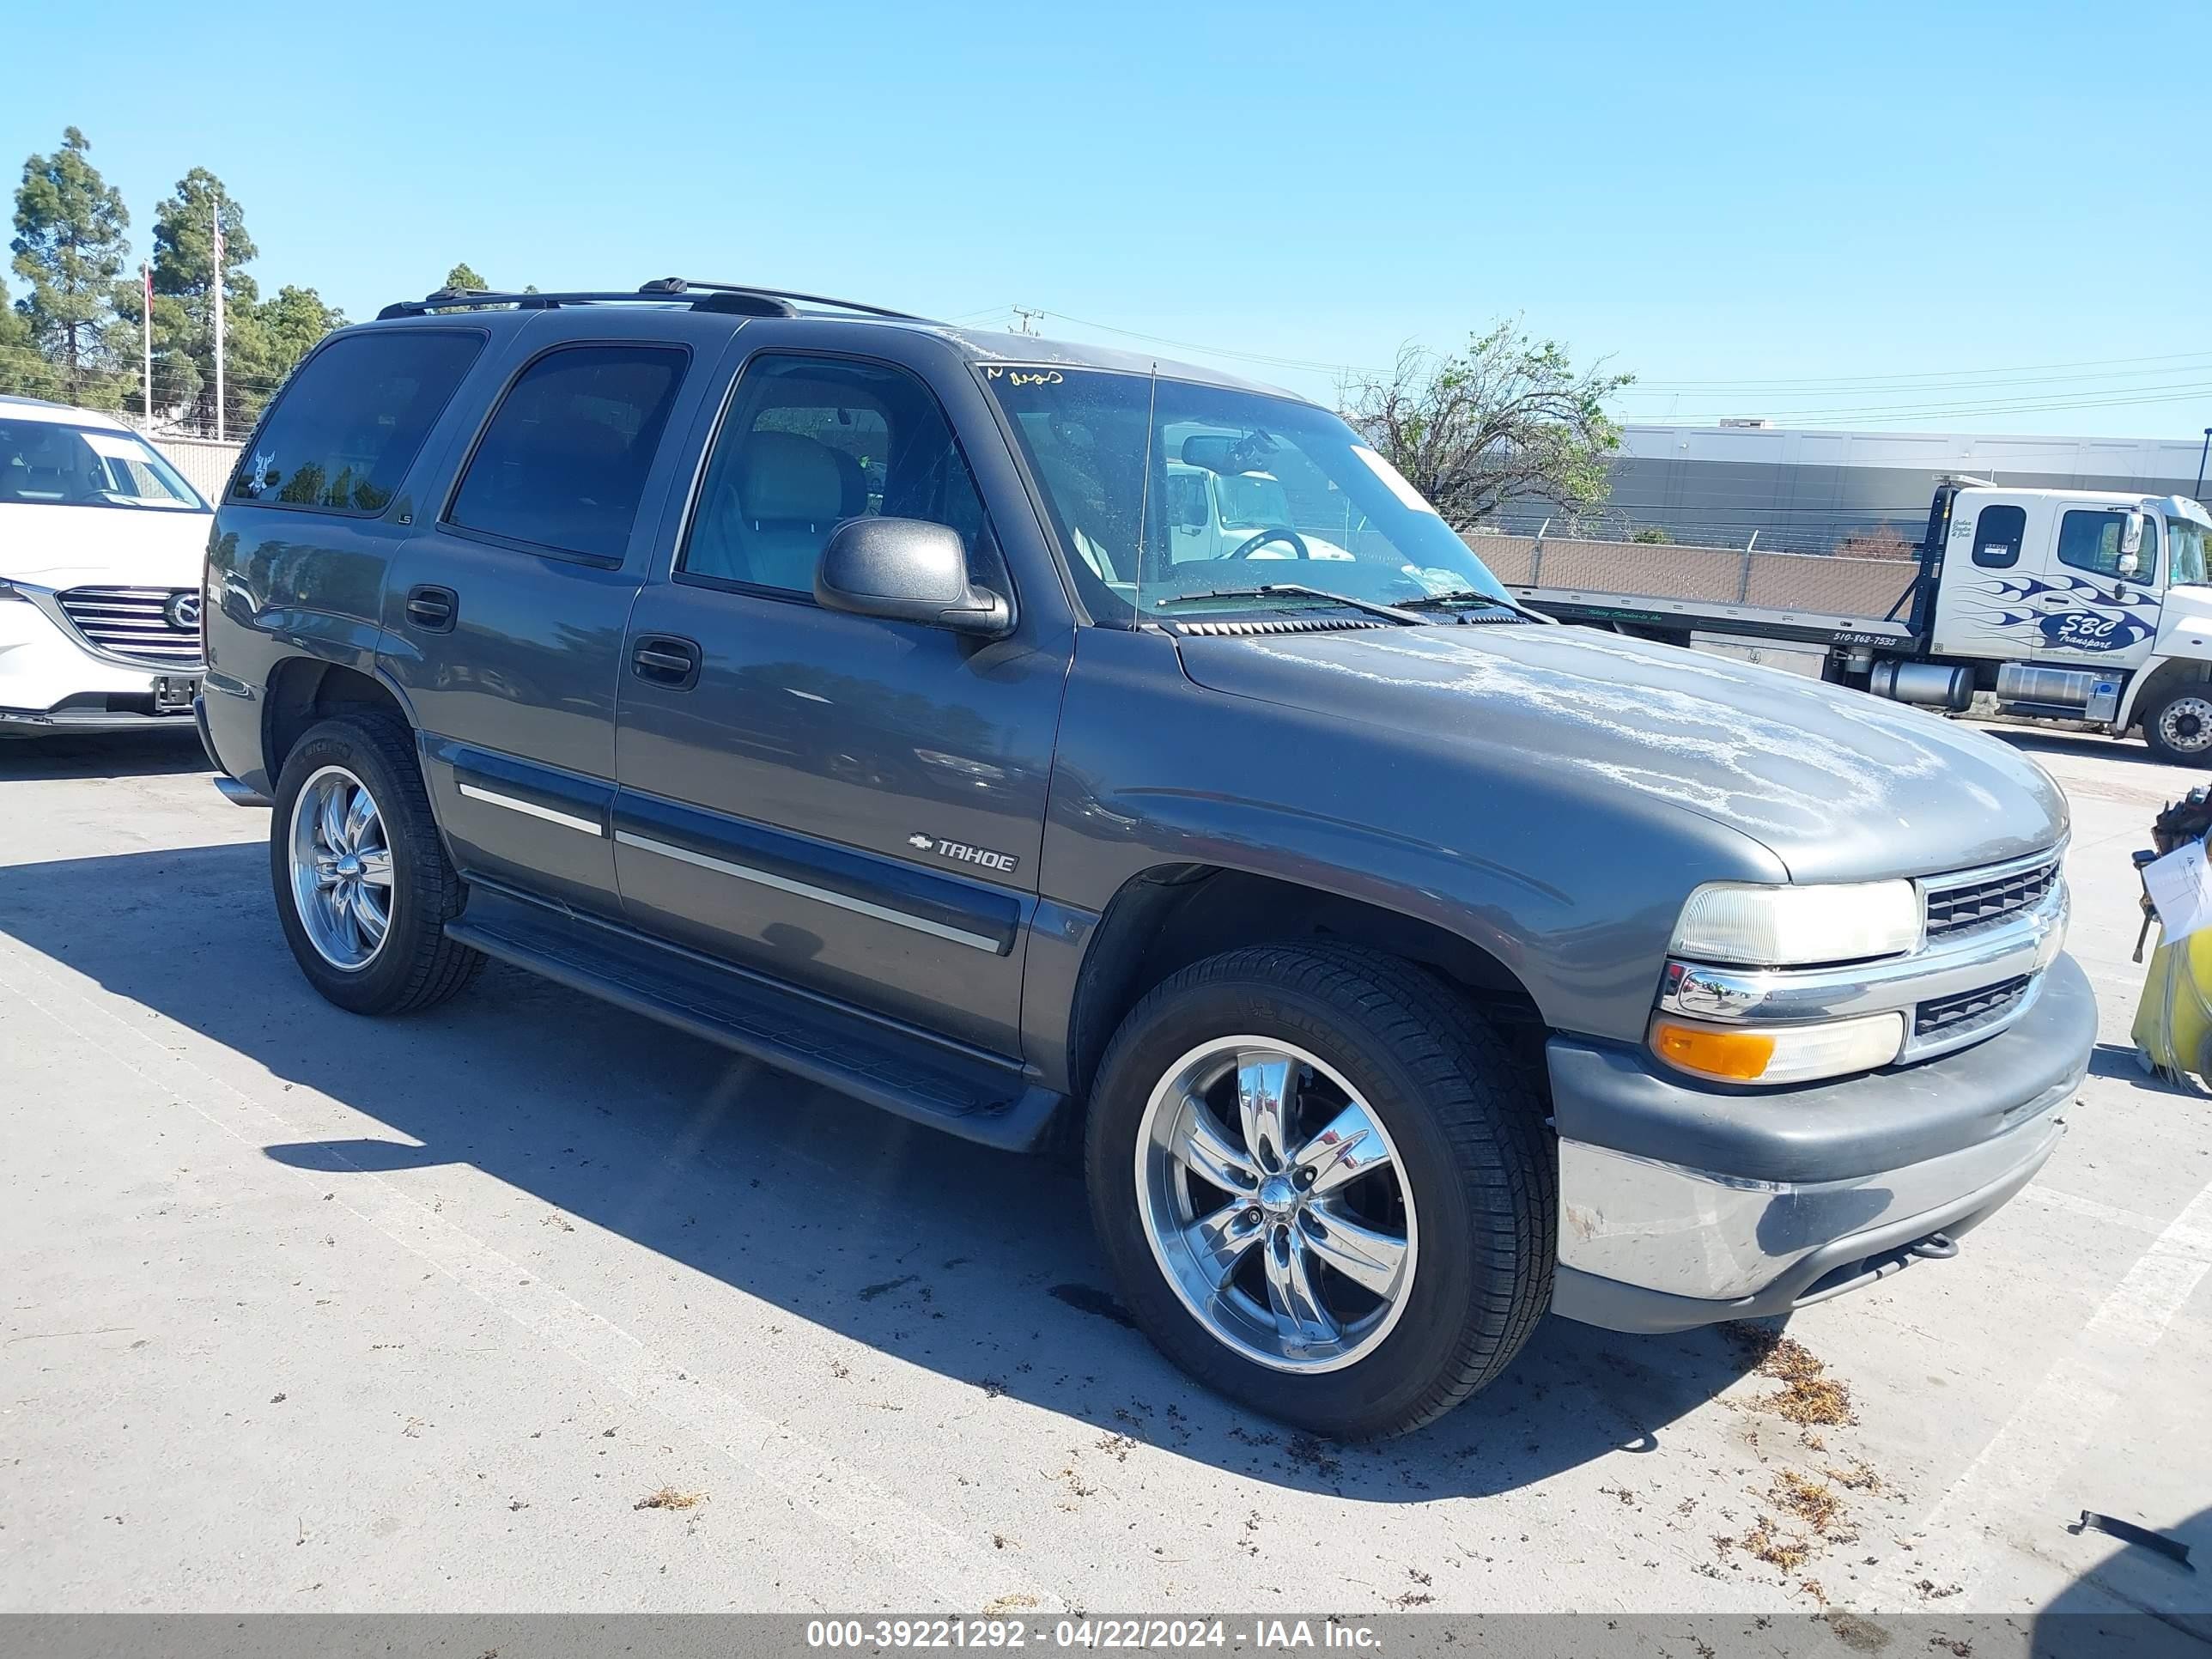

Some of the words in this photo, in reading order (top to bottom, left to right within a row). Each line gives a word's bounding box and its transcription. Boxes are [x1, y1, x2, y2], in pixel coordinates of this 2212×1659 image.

[398, 514, 411, 524] LS
[2059, 615, 2117, 637] SBC
[1833, 632, 1898, 646] 510-862-7535
[2057, 630, 2112, 649] Transport
[939, 840, 1015, 872] TAHOE
